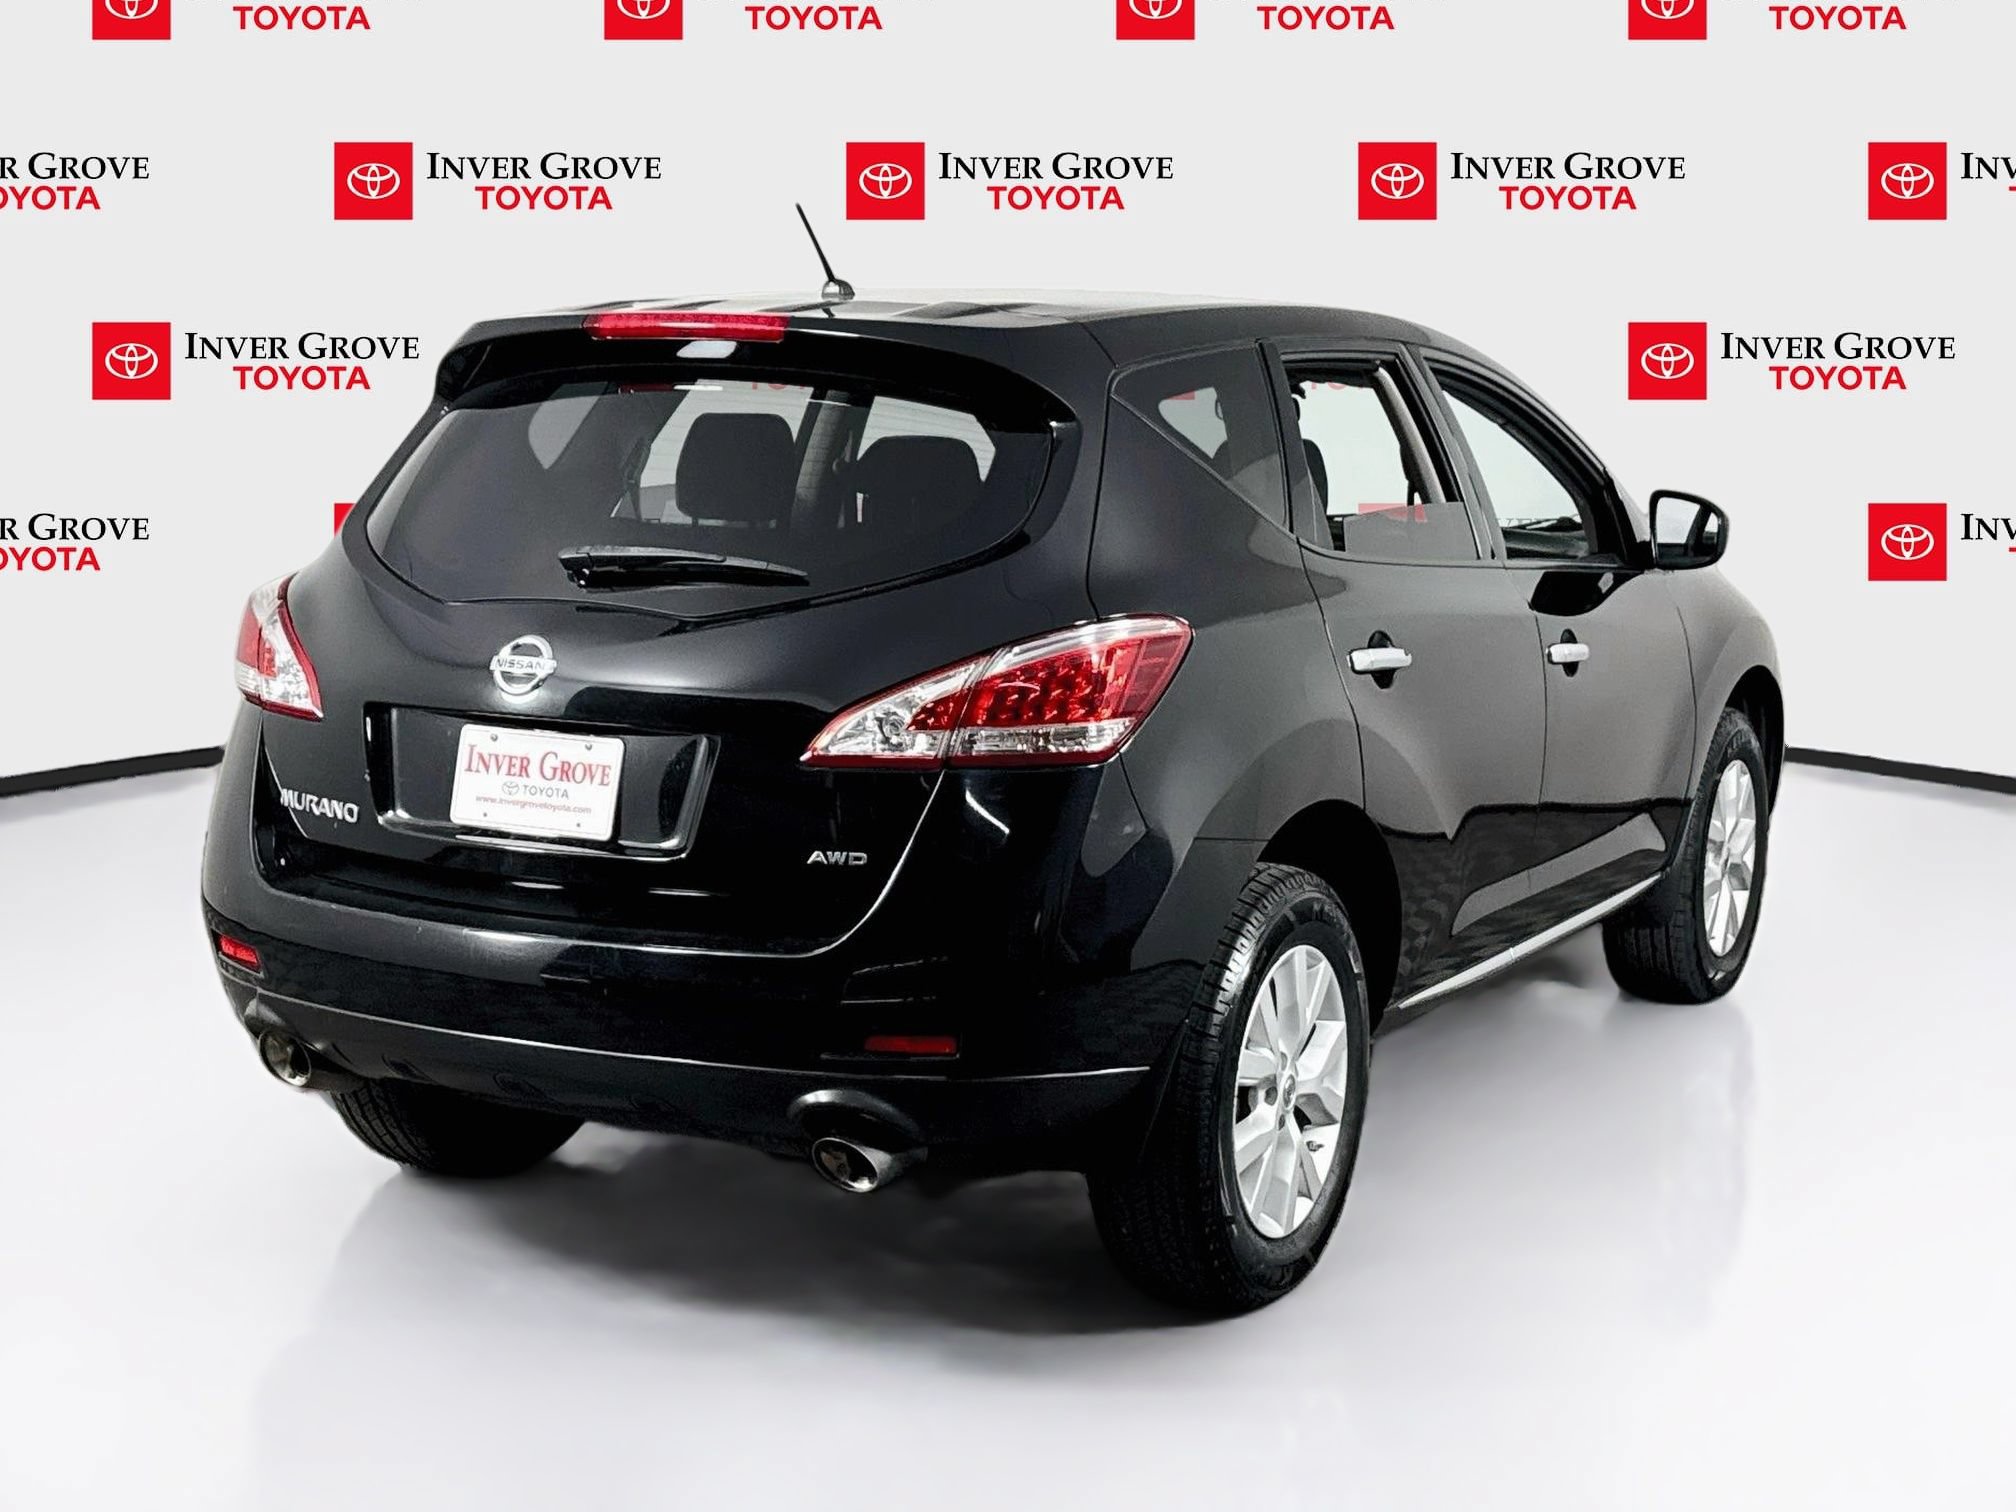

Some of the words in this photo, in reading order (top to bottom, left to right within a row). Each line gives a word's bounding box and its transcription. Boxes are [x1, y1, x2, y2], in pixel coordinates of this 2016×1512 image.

[233, 5, 370, 31] TOYOTA
[745, 5, 882, 31] TOYOTA
[1257, 5, 1394, 31] TOYOTA
[1769, 5, 1906, 31] TOYOTA
[28, 152, 149, 179] GROVE
[427, 152, 532, 179] INVER
[540, 152, 661, 179] GROVE
[939, 152, 1044, 179] INVER
[1052, 152, 1173, 179] GROVE
[1451, 152, 1556, 179] INVER
[1564, 152, 1685, 179] GROVE
[475, 185, 612, 210] TOYOTA
[987, 185, 1124, 210] TOYOTA
[1499, 185, 1636, 210] TOYOTA
[185, 332, 290, 359] INVER
[298, 332, 419, 359] GROVE
[1721, 332, 1826, 359] INVER
[1834, 332, 1955, 359] GROVE
[233, 365, 370, 390] TOYOTA
[1769, 365, 1906, 390] TOYOTA
[28, 513, 149, 540] GROVE
[495, 658, 545, 671] NISSAN
[464, 744, 531, 778] INVER
[540, 751, 612, 787] GROVE
[523, 784, 569, 799] TOYOTA
[280, 788, 360, 824] MURANO
[806, 850, 868, 866] AWD
